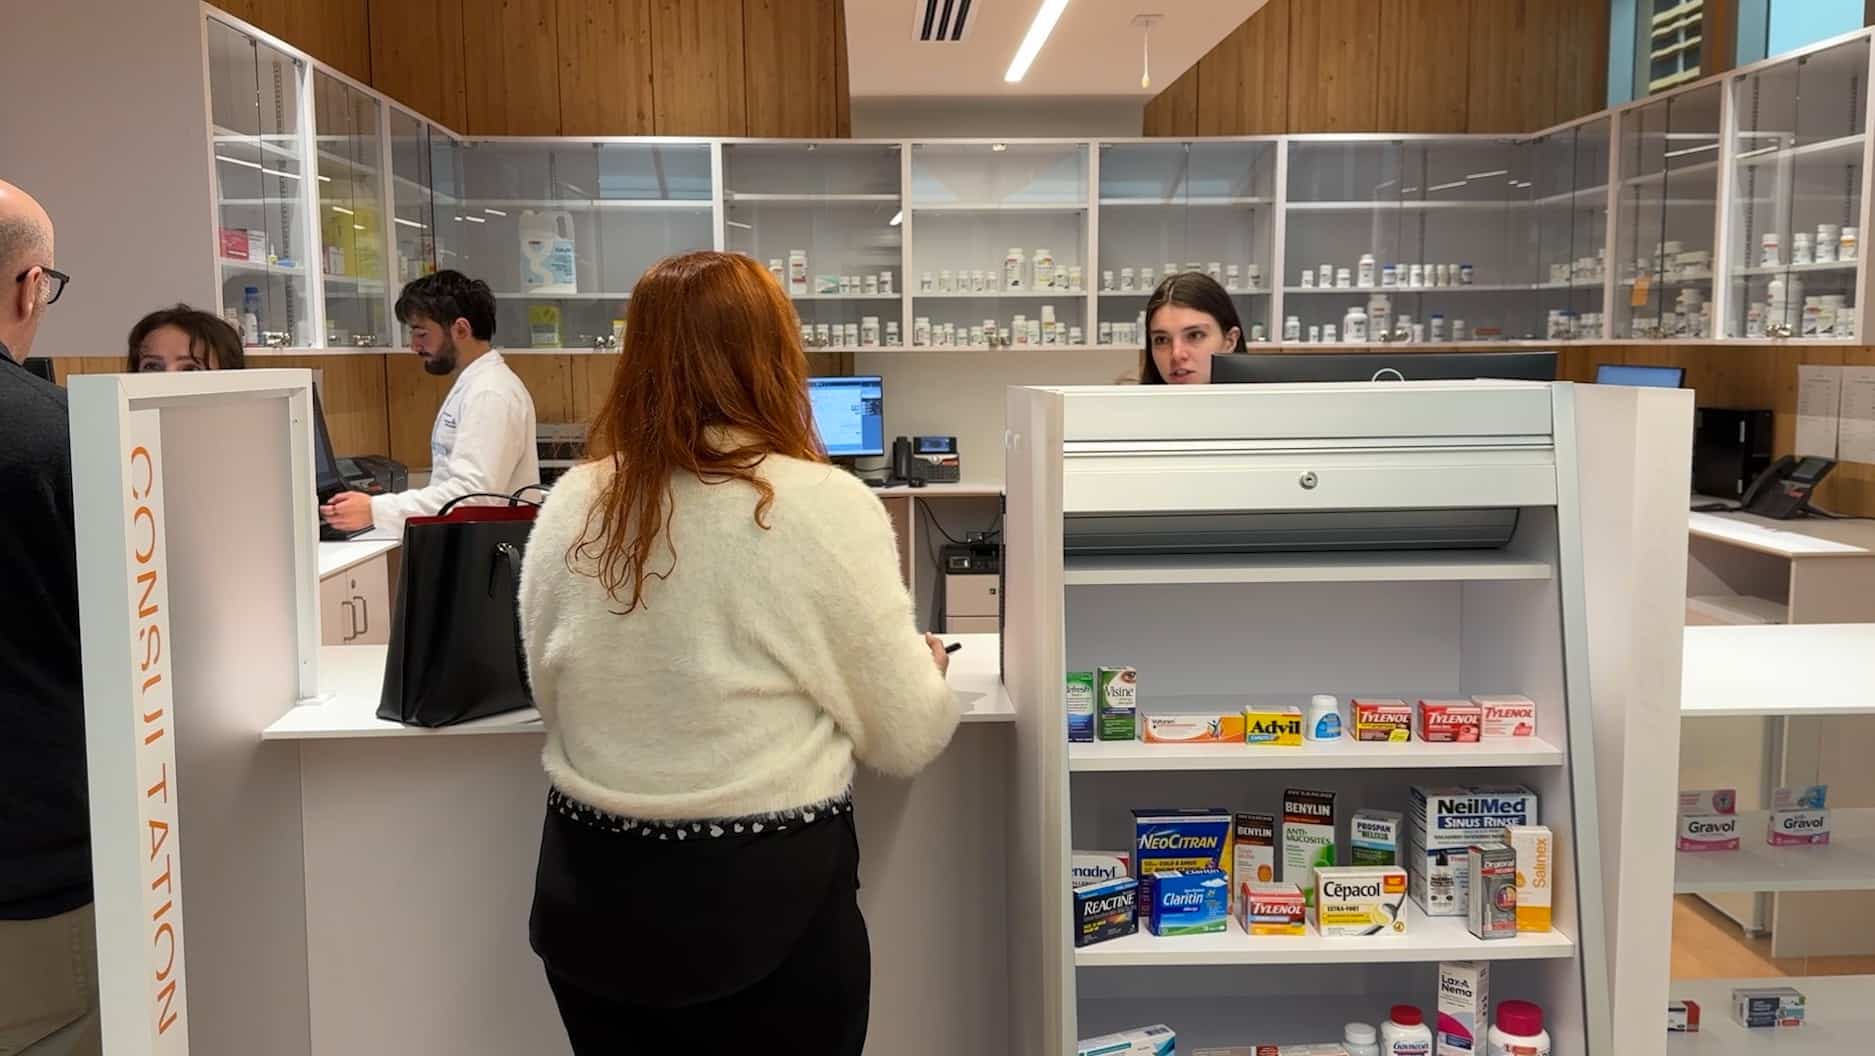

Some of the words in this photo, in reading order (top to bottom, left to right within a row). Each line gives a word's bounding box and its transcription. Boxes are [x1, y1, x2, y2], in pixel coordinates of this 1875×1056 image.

[1104, 686, 1133, 697] Visine
[1361, 711, 1409, 723] TYLENOL
[1428, 712, 1480, 724] TYLENOL
[1484, 707, 1533, 719] TYLENOL
[1250, 720, 1300, 734] Advil
[1285, 801, 1331, 816] BENYLIN
[1438, 798, 1526, 814] NeilMed
[1445, 817, 1480, 828] SINUS
[1484, 816, 1520, 827] RINSE
[1688, 820, 1736, 834] Gravol
[1783, 817, 1824, 830] Gravol
[1237, 826, 1272, 837] BENYLIN
[1533, 837, 1547, 889] Salinex
[1072, 865, 1116, 880] nadryl
[1084, 894, 1135, 916] REACTINE
[1163, 892, 1204, 906] Claritin
[1253, 902, 1302, 914] TYLENOL
[1441, 983, 1472, 998] Nema
